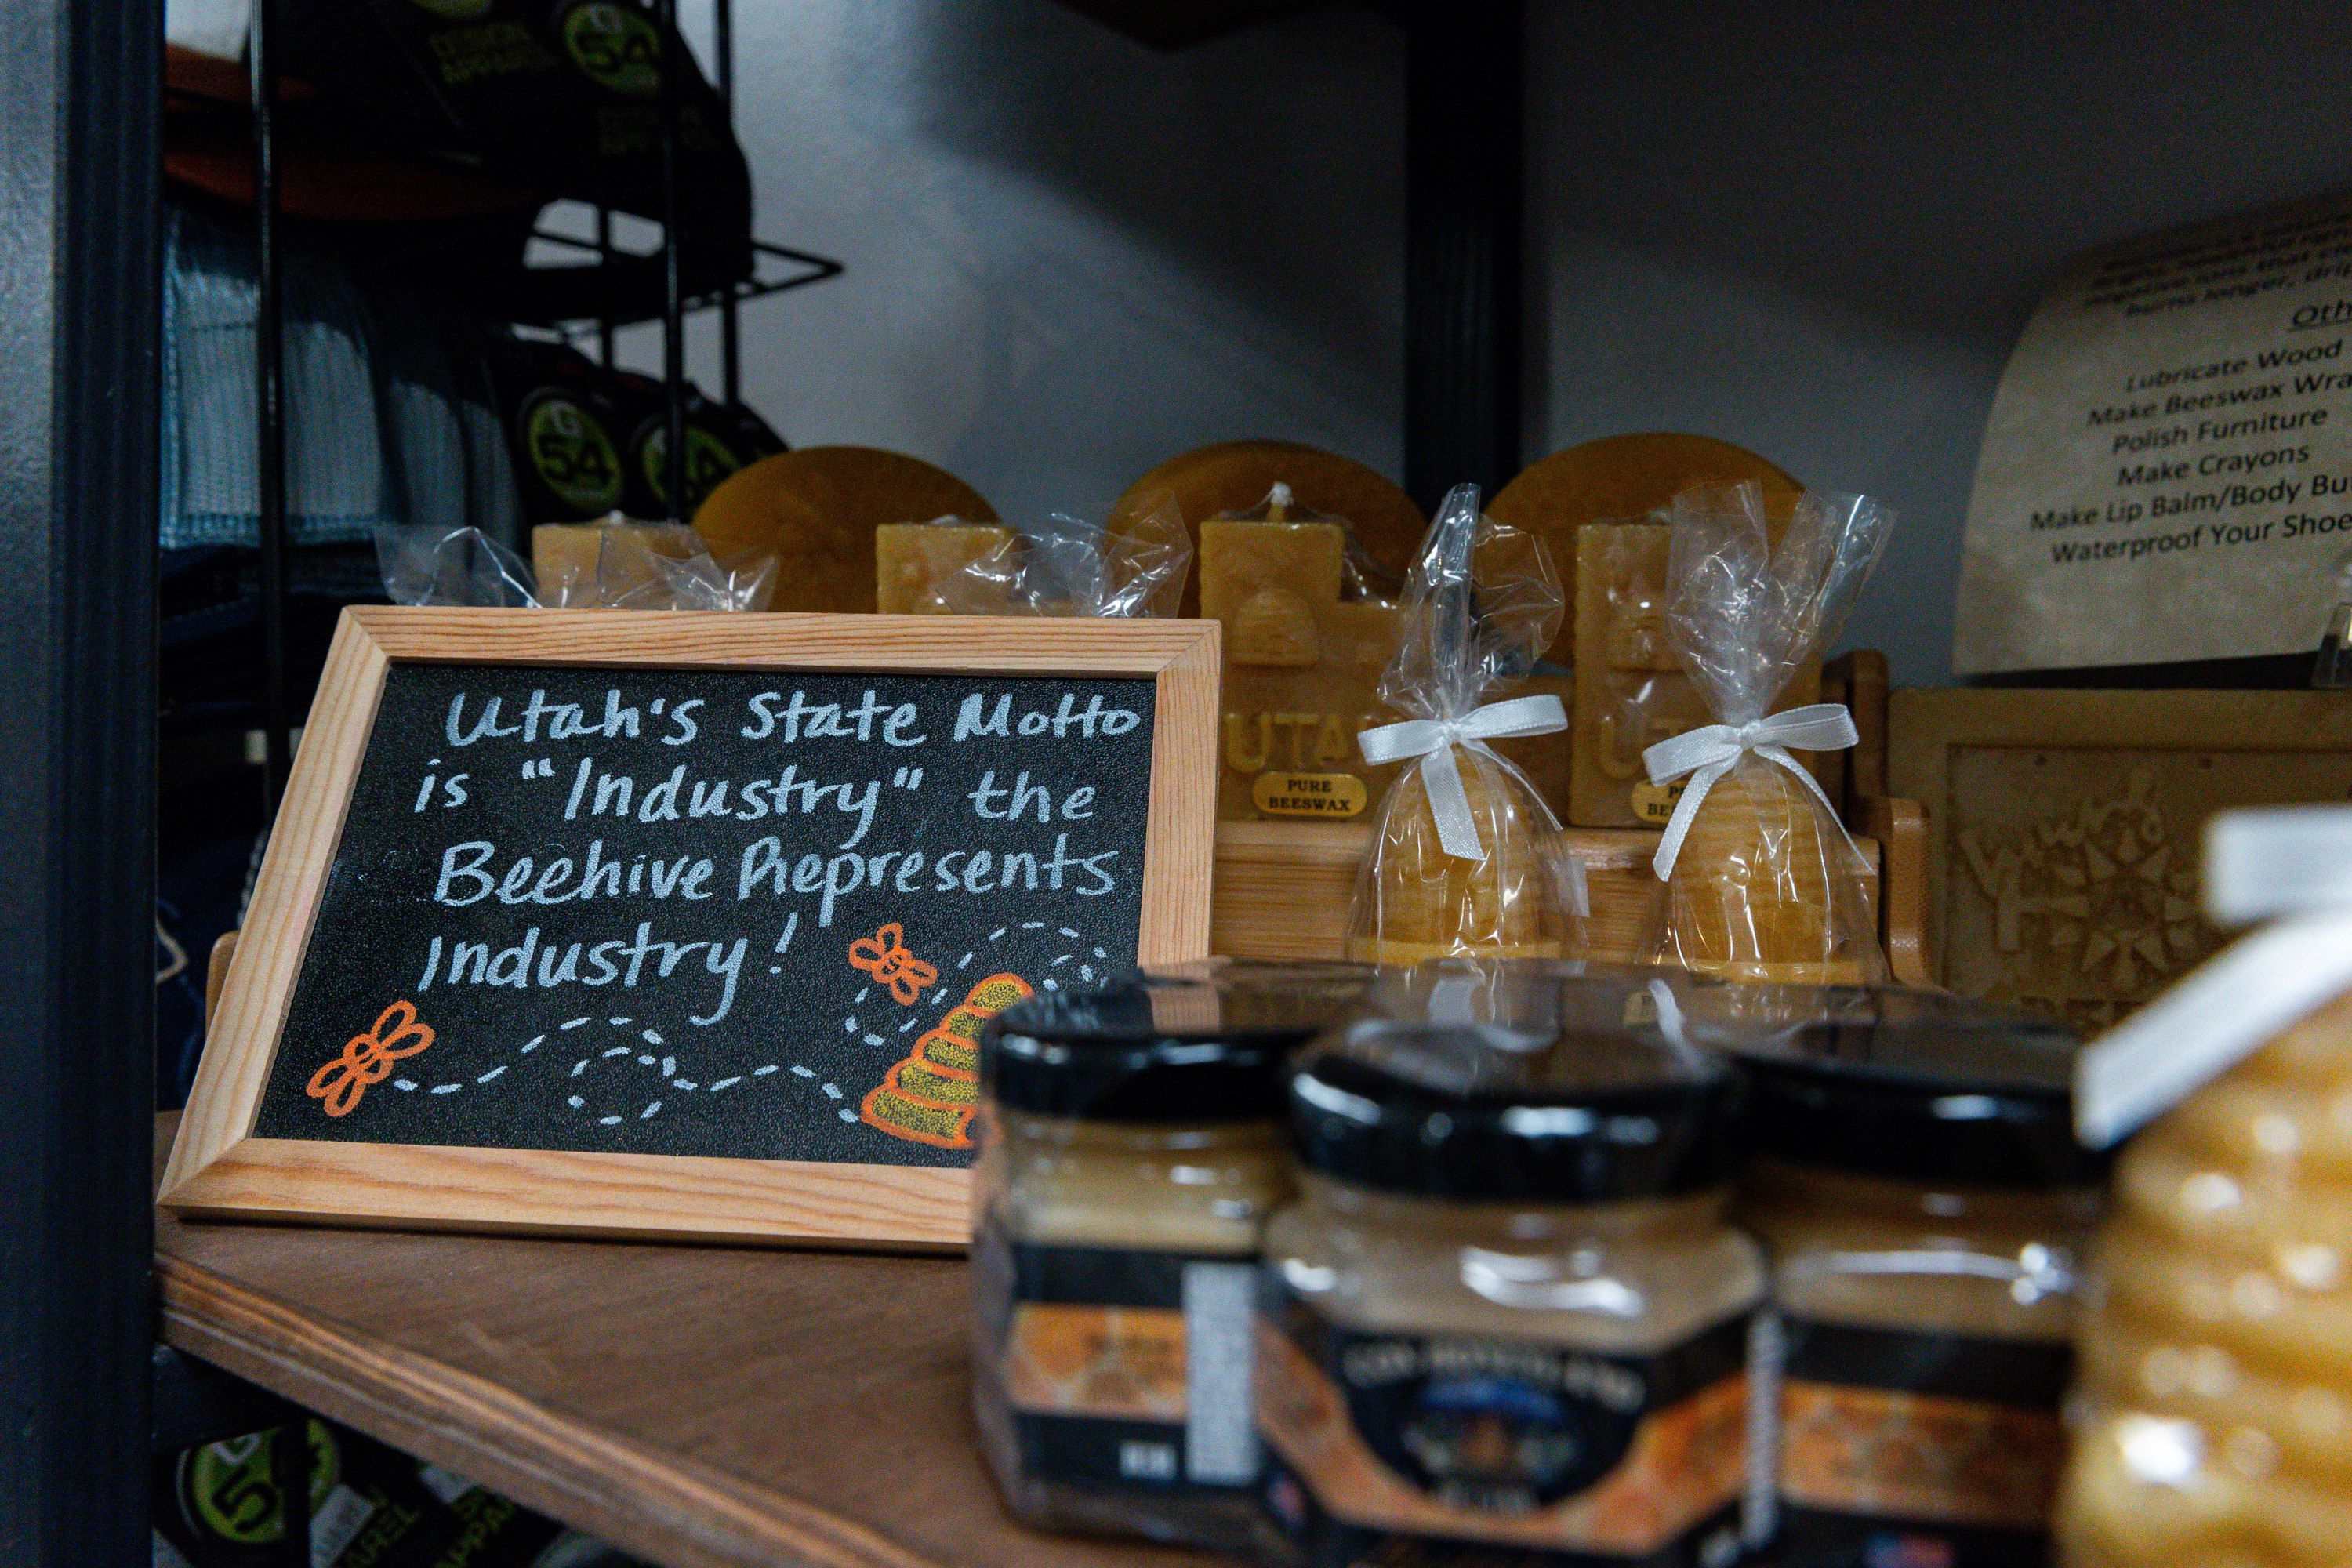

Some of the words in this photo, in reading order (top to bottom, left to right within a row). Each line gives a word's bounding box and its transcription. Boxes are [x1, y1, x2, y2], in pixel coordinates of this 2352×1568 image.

[2125, 358, 2248, 392] Lubricate
[2257, 339, 2344, 369] Wood
[2087, 403, 2158, 426] Make
[2165, 383, 2283, 415] Beeswax
[2112, 426, 2188, 455] Polish
[2197, 407, 2328, 441] Furniture
[2117, 461, 2190, 487] Make
[2198, 445, 2310, 476] Crayons
[2031, 506, 2099, 532] Make
[2106, 500, 2143, 525] Lip
[2151, 479, 2302, 519] Balm/Body
[2051, 524, 2201, 565] Waterproof
[2209, 521, 2275, 547] Your
[445, 690, 704, 746] Utah's
[742, 691, 926, 746] State
[954, 694, 1140, 741] Motto
[1224, 712, 1392, 772] UTA
[416, 759, 468, 811] is
[522, 757, 923, 849] "Industry"
[968, 771, 1094, 822] the
[1269, 796, 1350, 811] BEESWAX
[1287, 779, 1332, 793] PURE
[436, 840, 713, 906] Beehive
[739, 833, 1118, 929] Represents
[419, 913, 797, 1025] Industry!
